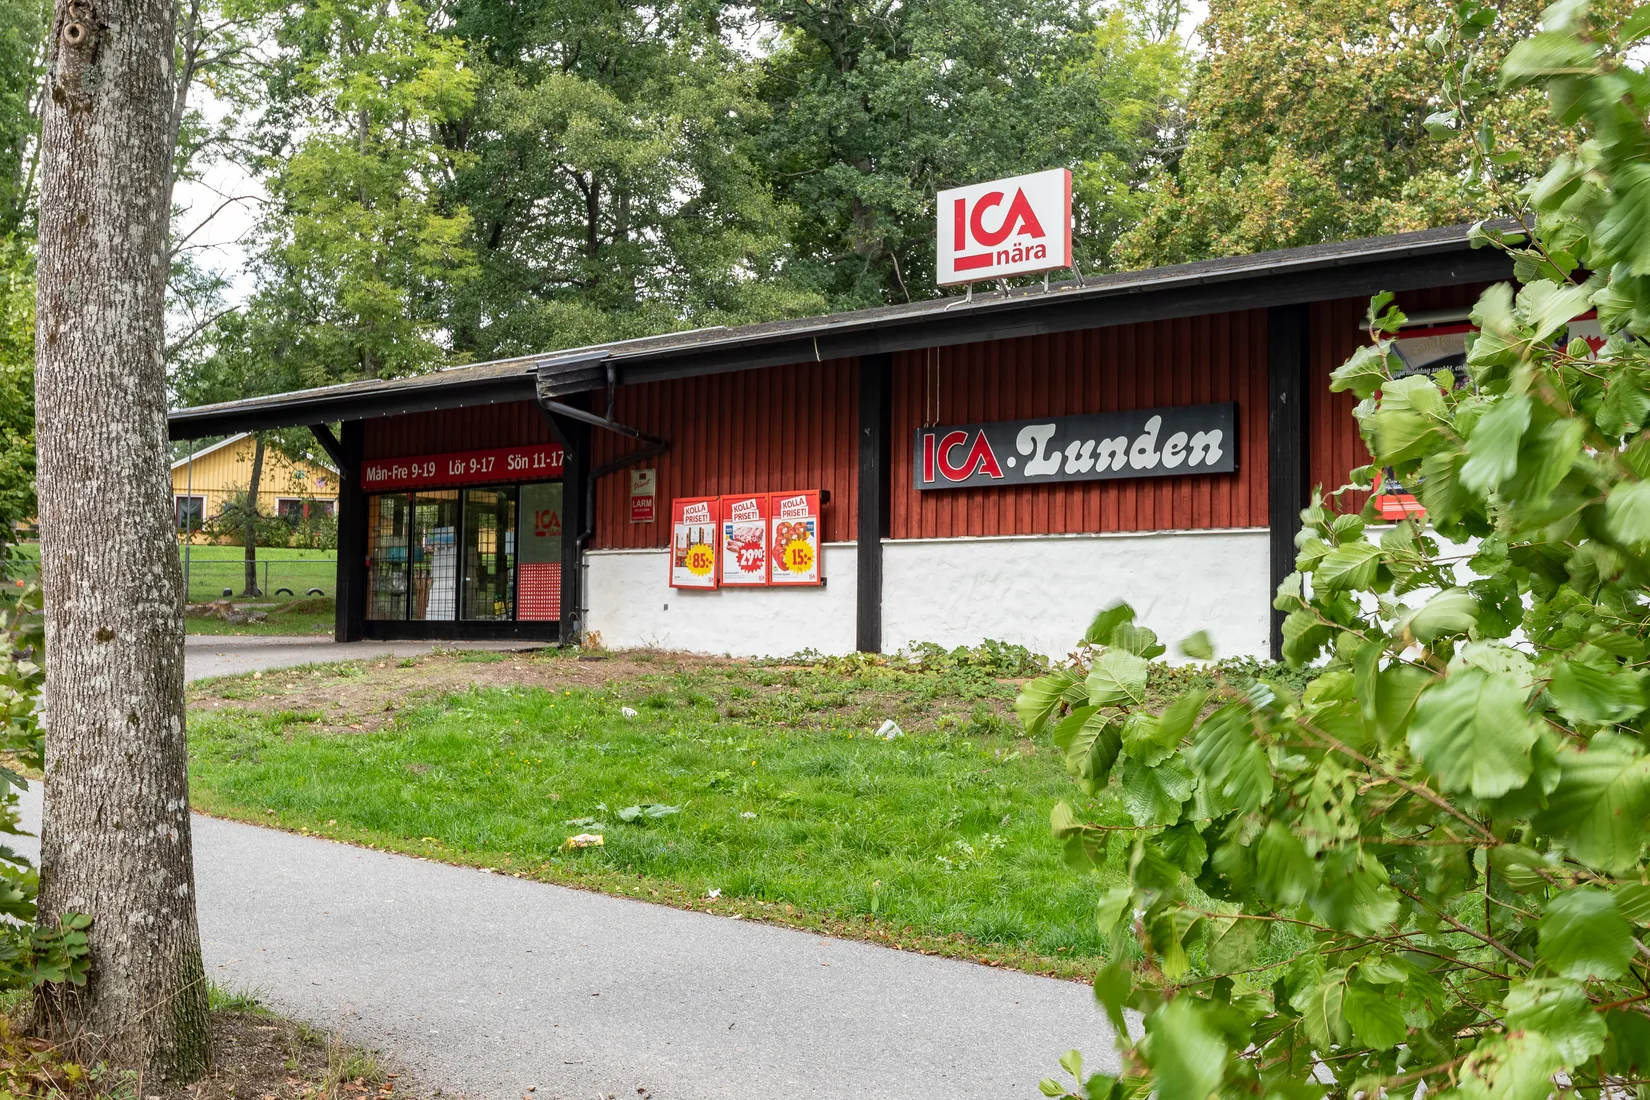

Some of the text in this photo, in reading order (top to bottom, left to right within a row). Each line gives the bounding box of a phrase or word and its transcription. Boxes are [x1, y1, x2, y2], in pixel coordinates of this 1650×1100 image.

[954, 186, 1046, 247] ICA
[997, 242, 1046, 265] nära
[923, 414, 1223, 483] ICA Lunden
[366, 451, 564, 481] Mån-Fre 9-19 Lör 9-17 Sön 11-17
[632, 499, 652, 508] LARM
[733, 501, 755, 512] KOLLA
[782, 498, 805, 509] KOLLA
[685, 504, 706, 515] KOLLA
[782, 508, 807, 517] PRISET!
[535, 509, 561, 530] ICA
[685, 515, 708, 523] PRISET!
[733, 512, 758, 520] PRISET!
[792, 549, 811, 566] 15:-
